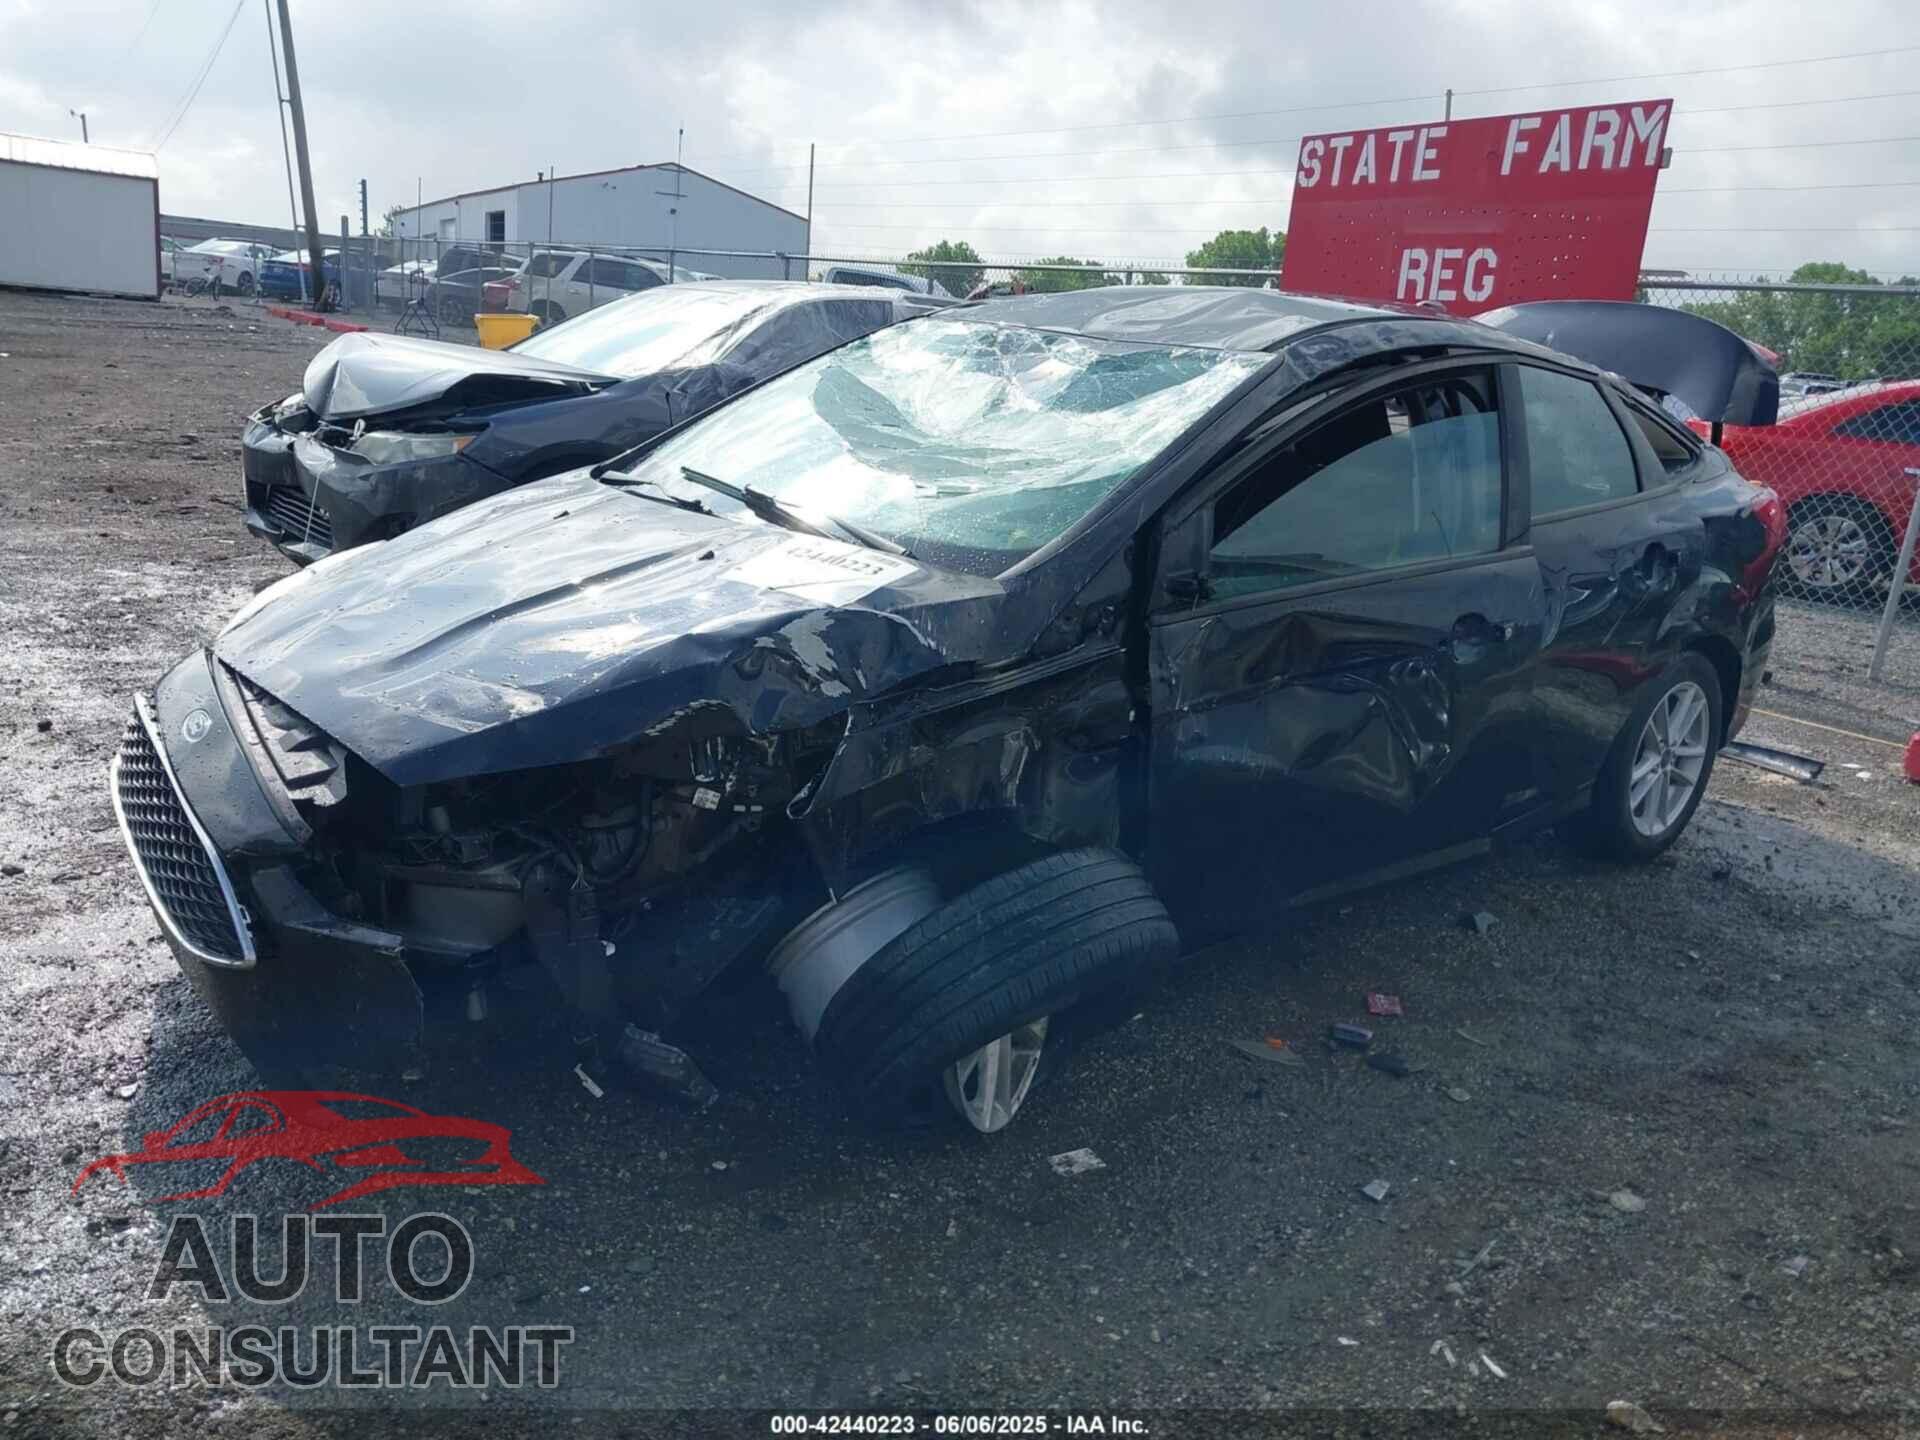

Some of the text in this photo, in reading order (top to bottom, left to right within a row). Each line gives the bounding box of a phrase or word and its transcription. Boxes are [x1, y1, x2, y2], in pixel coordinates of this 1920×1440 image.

[1298, 104, 1668, 188] STATE FARM
[1396, 247, 1498, 302] REG
